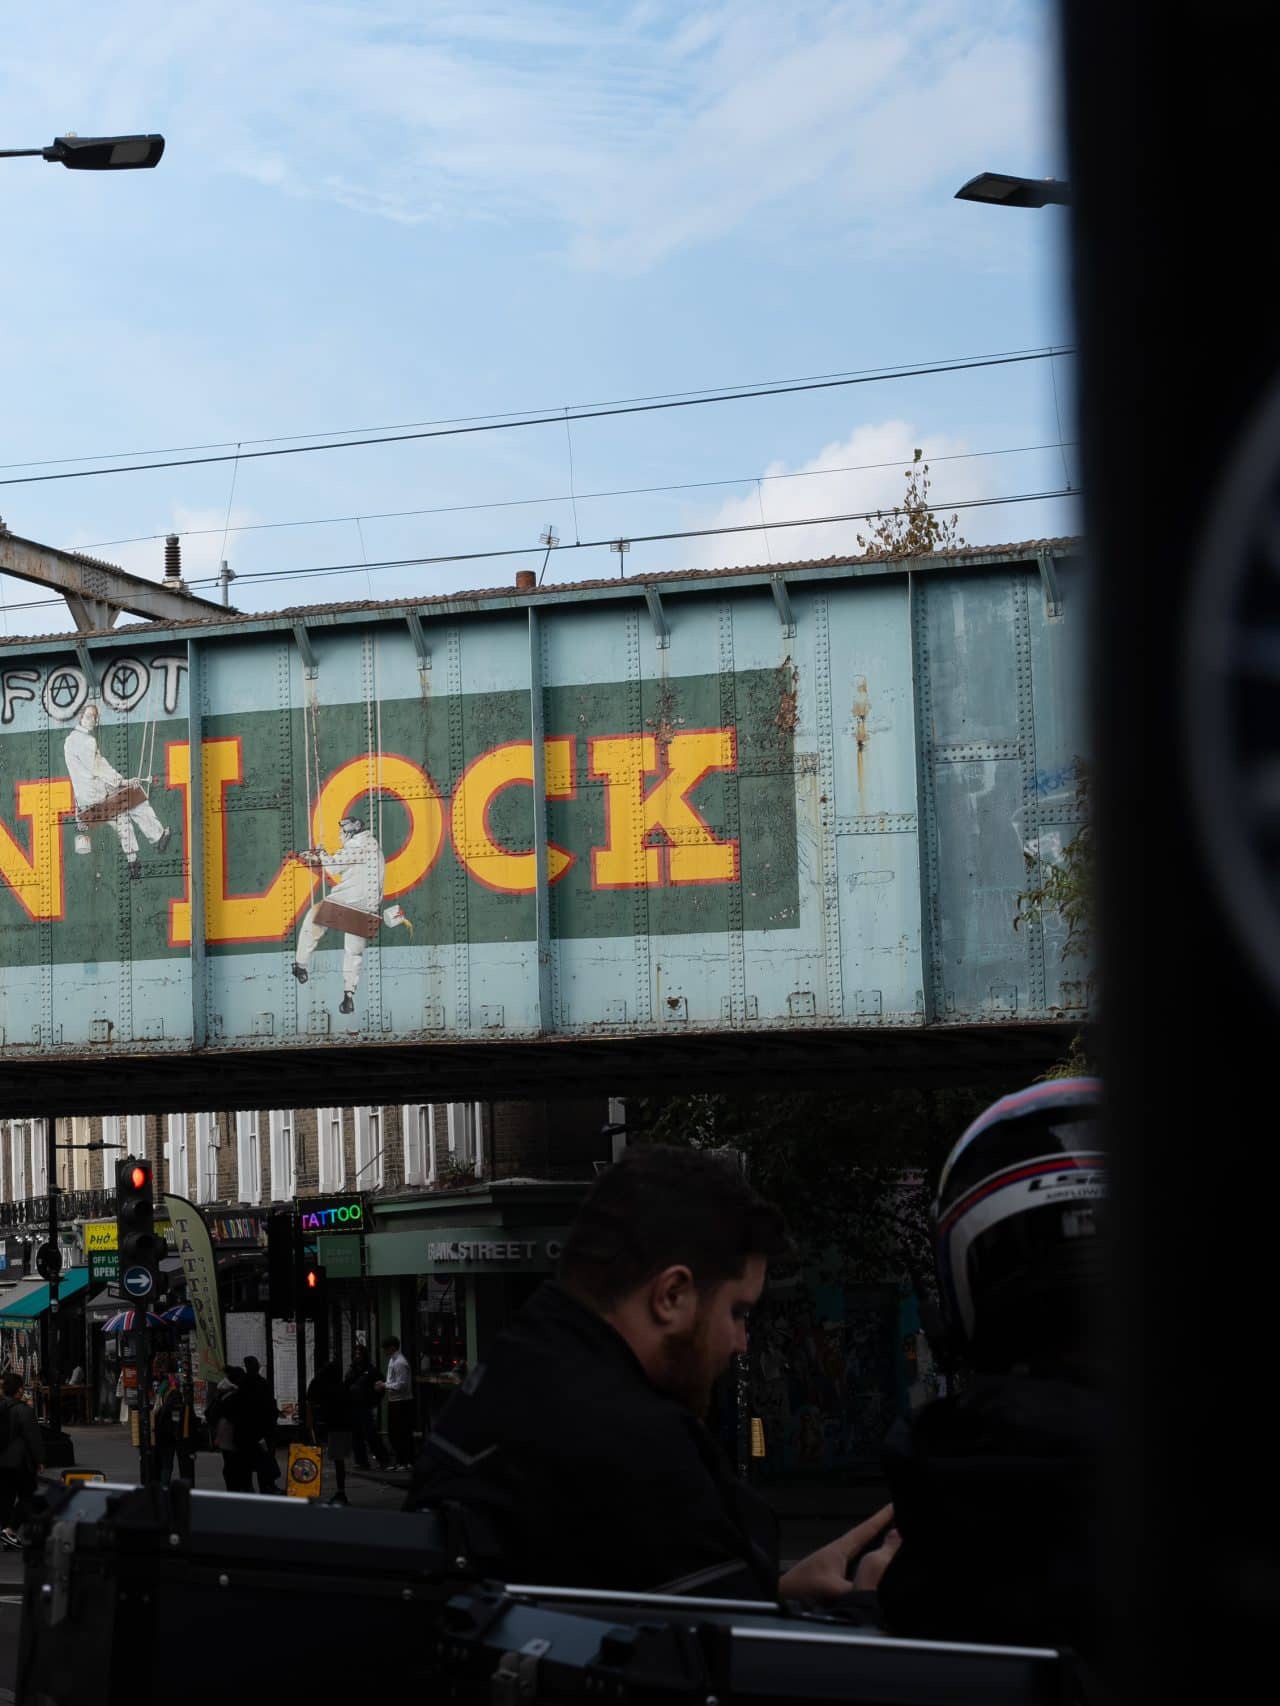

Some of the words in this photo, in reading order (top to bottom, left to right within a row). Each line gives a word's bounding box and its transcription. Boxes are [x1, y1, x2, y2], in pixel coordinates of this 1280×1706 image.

[165, 727, 740, 948] LOCK
[301, 1204, 361, 1231] TATTOO
[92, 1255, 106, 1265] OFF
[457, 1240, 537, 1261] STREET
[93, 1266, 116, 1278] OPEN
